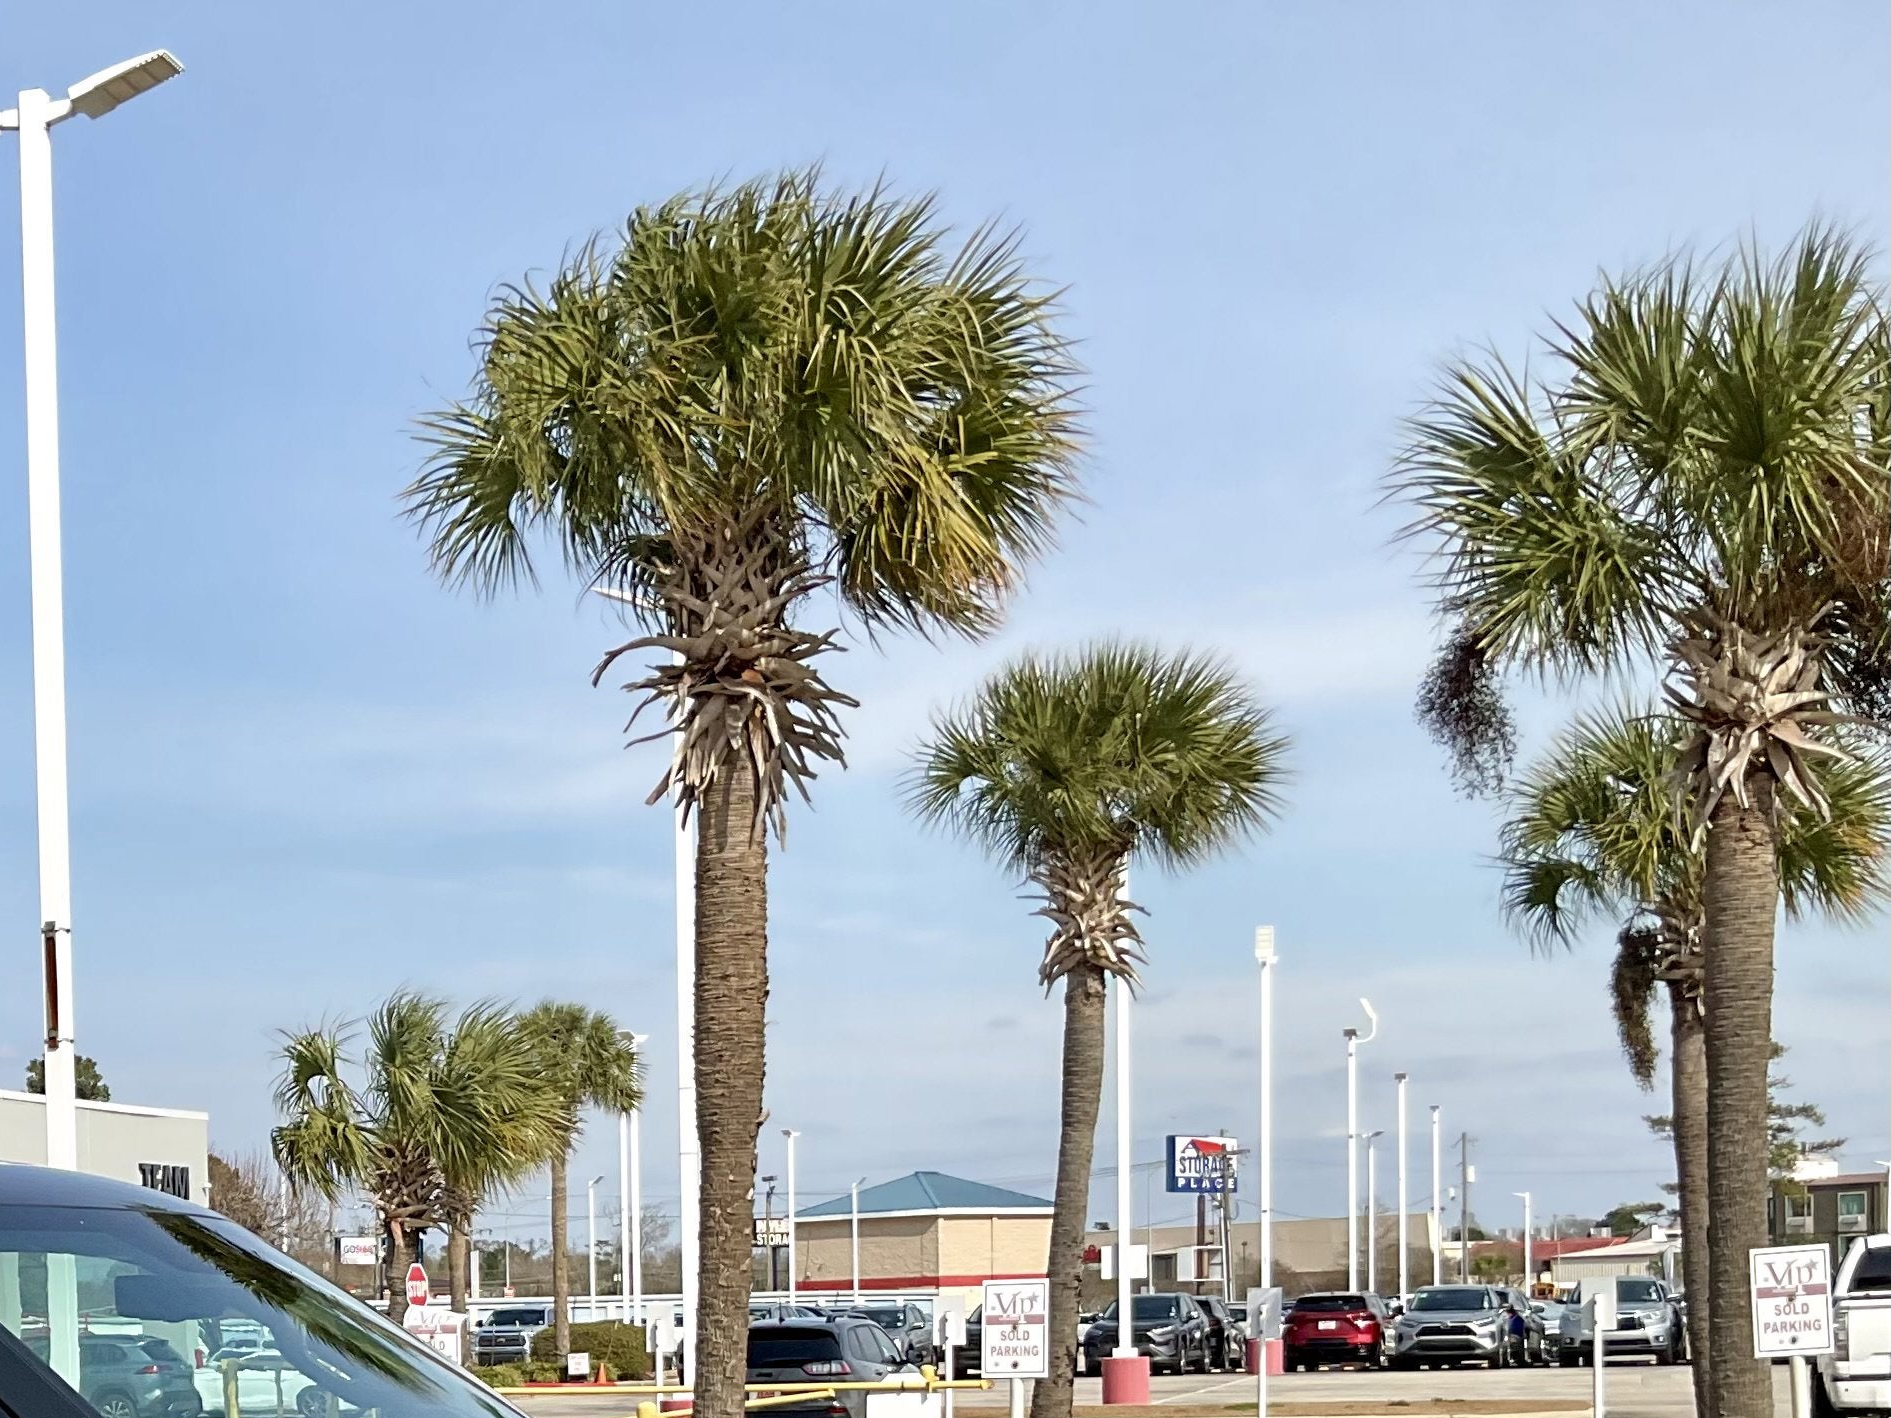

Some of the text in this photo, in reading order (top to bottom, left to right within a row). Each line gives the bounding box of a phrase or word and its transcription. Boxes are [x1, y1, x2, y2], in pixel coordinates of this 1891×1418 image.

[138, 1163, 190, 1200] TEAM
[1177, 1177, 1235, 1189] PLACE
[756, 1233, 789, 1246] STORA
[408, 1280, 427, 1298] STOP
[1774, 1302, 1810, 1317] SOLD
[1763, 1319, 1822, 1335] PARKING
[1000, 1330, 1030, 1342] SOLD
[990, 1345, 1039, 1358] PARKING
